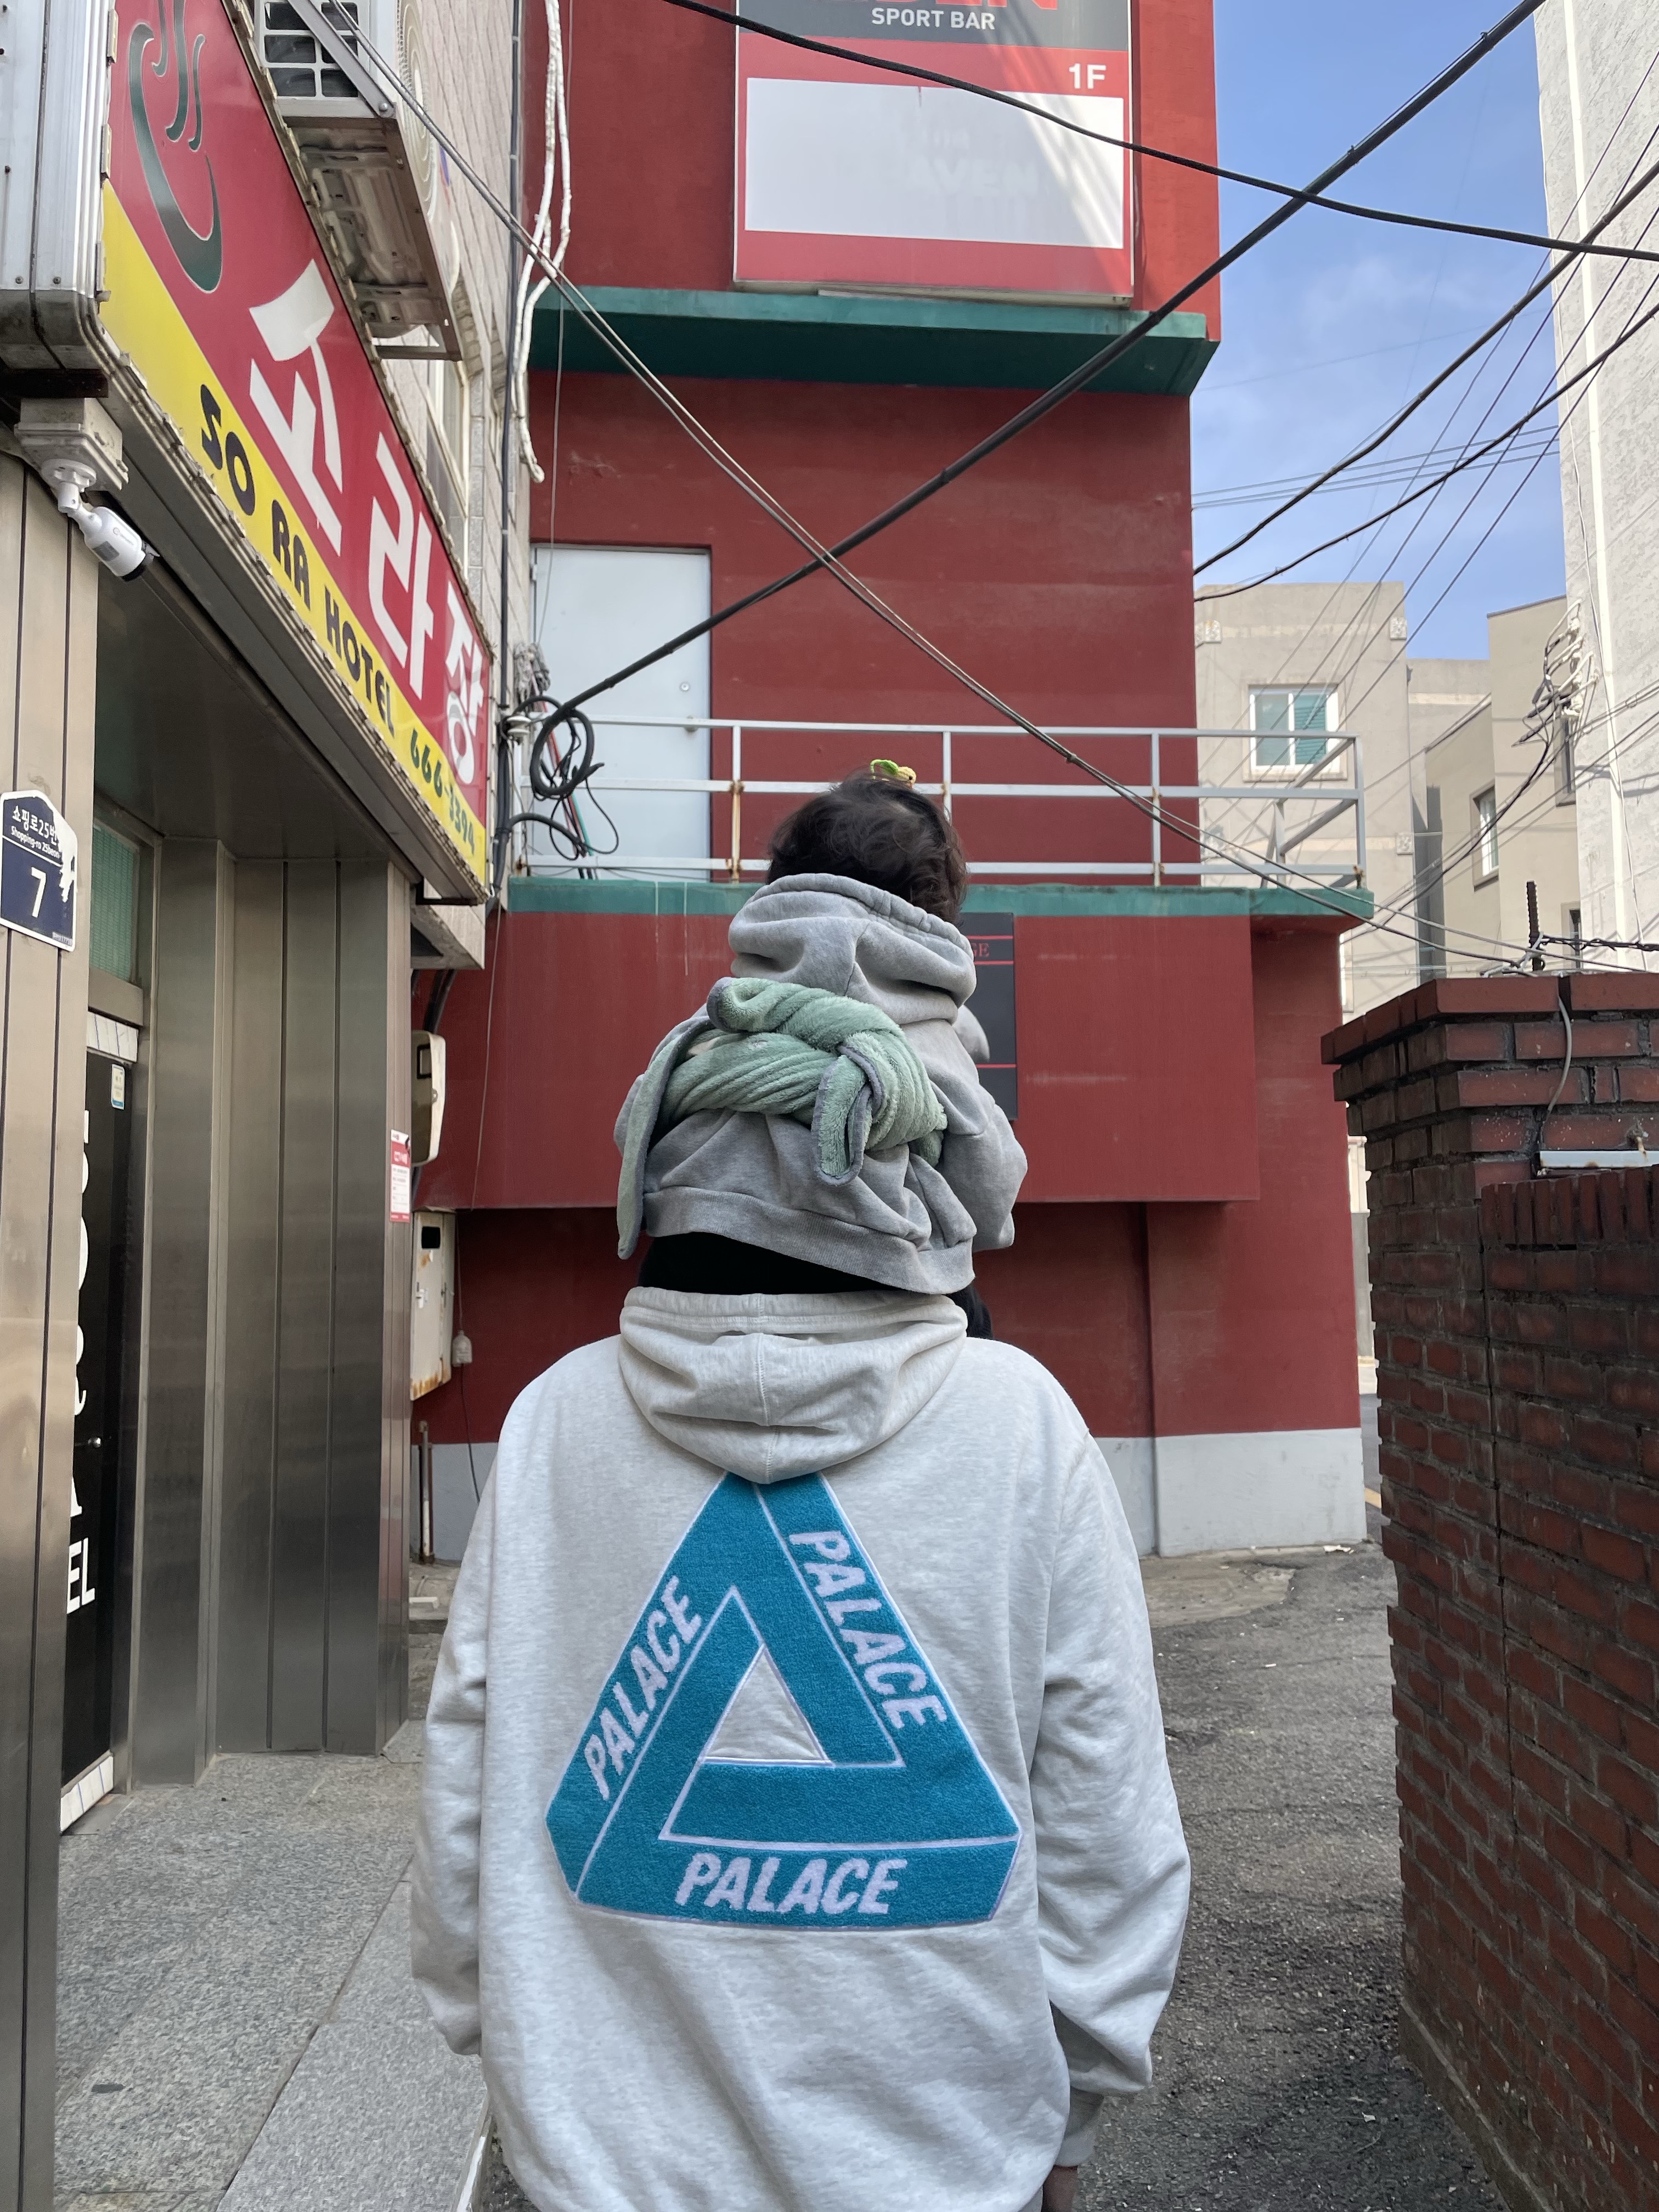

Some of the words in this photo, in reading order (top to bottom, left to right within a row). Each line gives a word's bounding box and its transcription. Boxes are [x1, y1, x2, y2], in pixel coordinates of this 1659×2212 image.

[871, 7, 944, 28] SPORT
[950, 11, 996, 30] BAR
[1069, 63, 1107, 89] 1F
[249, 259, 484, 785] 소라장
[200, 383, 256, 516] SO
[272, 499, 311, 611] RA
[324, 584, 395, 738] HOTEL
[12, 805, 57, 846] 쇼핑로25번
[31, 866, 47, 918] 7
[66, 1537, 95, 1615] EL
[788, 1530, 947, 1729] PALACE
[584, 1575, 702, 1801] PALACE
[675, 1853, 907, 1915] PALACE
